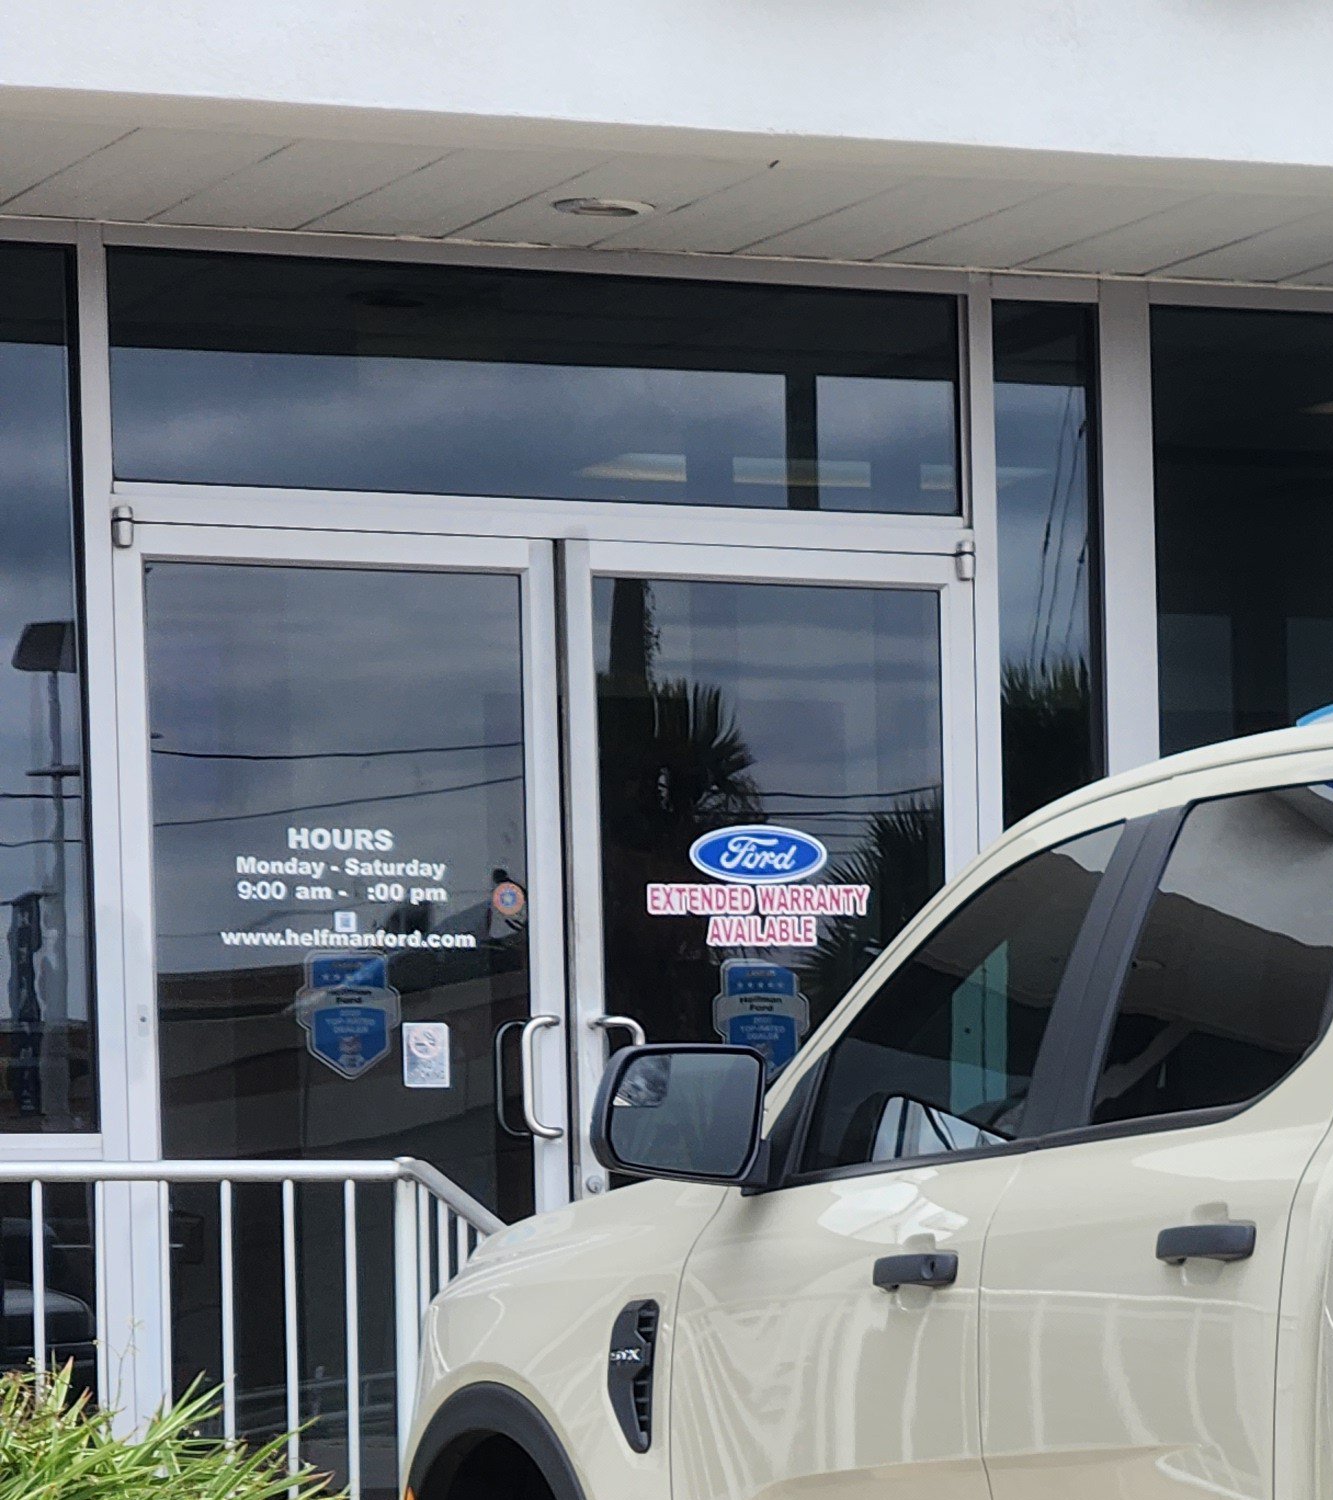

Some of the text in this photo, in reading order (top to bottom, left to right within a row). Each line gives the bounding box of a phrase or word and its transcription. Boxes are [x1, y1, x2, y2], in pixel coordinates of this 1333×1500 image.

[287, 827, 394, 851] HOURS
[719, 836, 797, 870] Ford
[235, 856, 325, 879] Monday
[344, 858, 446, 881] Saturday
[237, 881, 286, 900] 9:00
[295, 886, 332, 901] am
[410, 886, 448, 905] pm
[649, 886, 868, 913] EXTENDED WARRANTY
[220, 929, 477, 948] www.helfmanford.com
[709, 918, 815, 944] AVAILABLE
